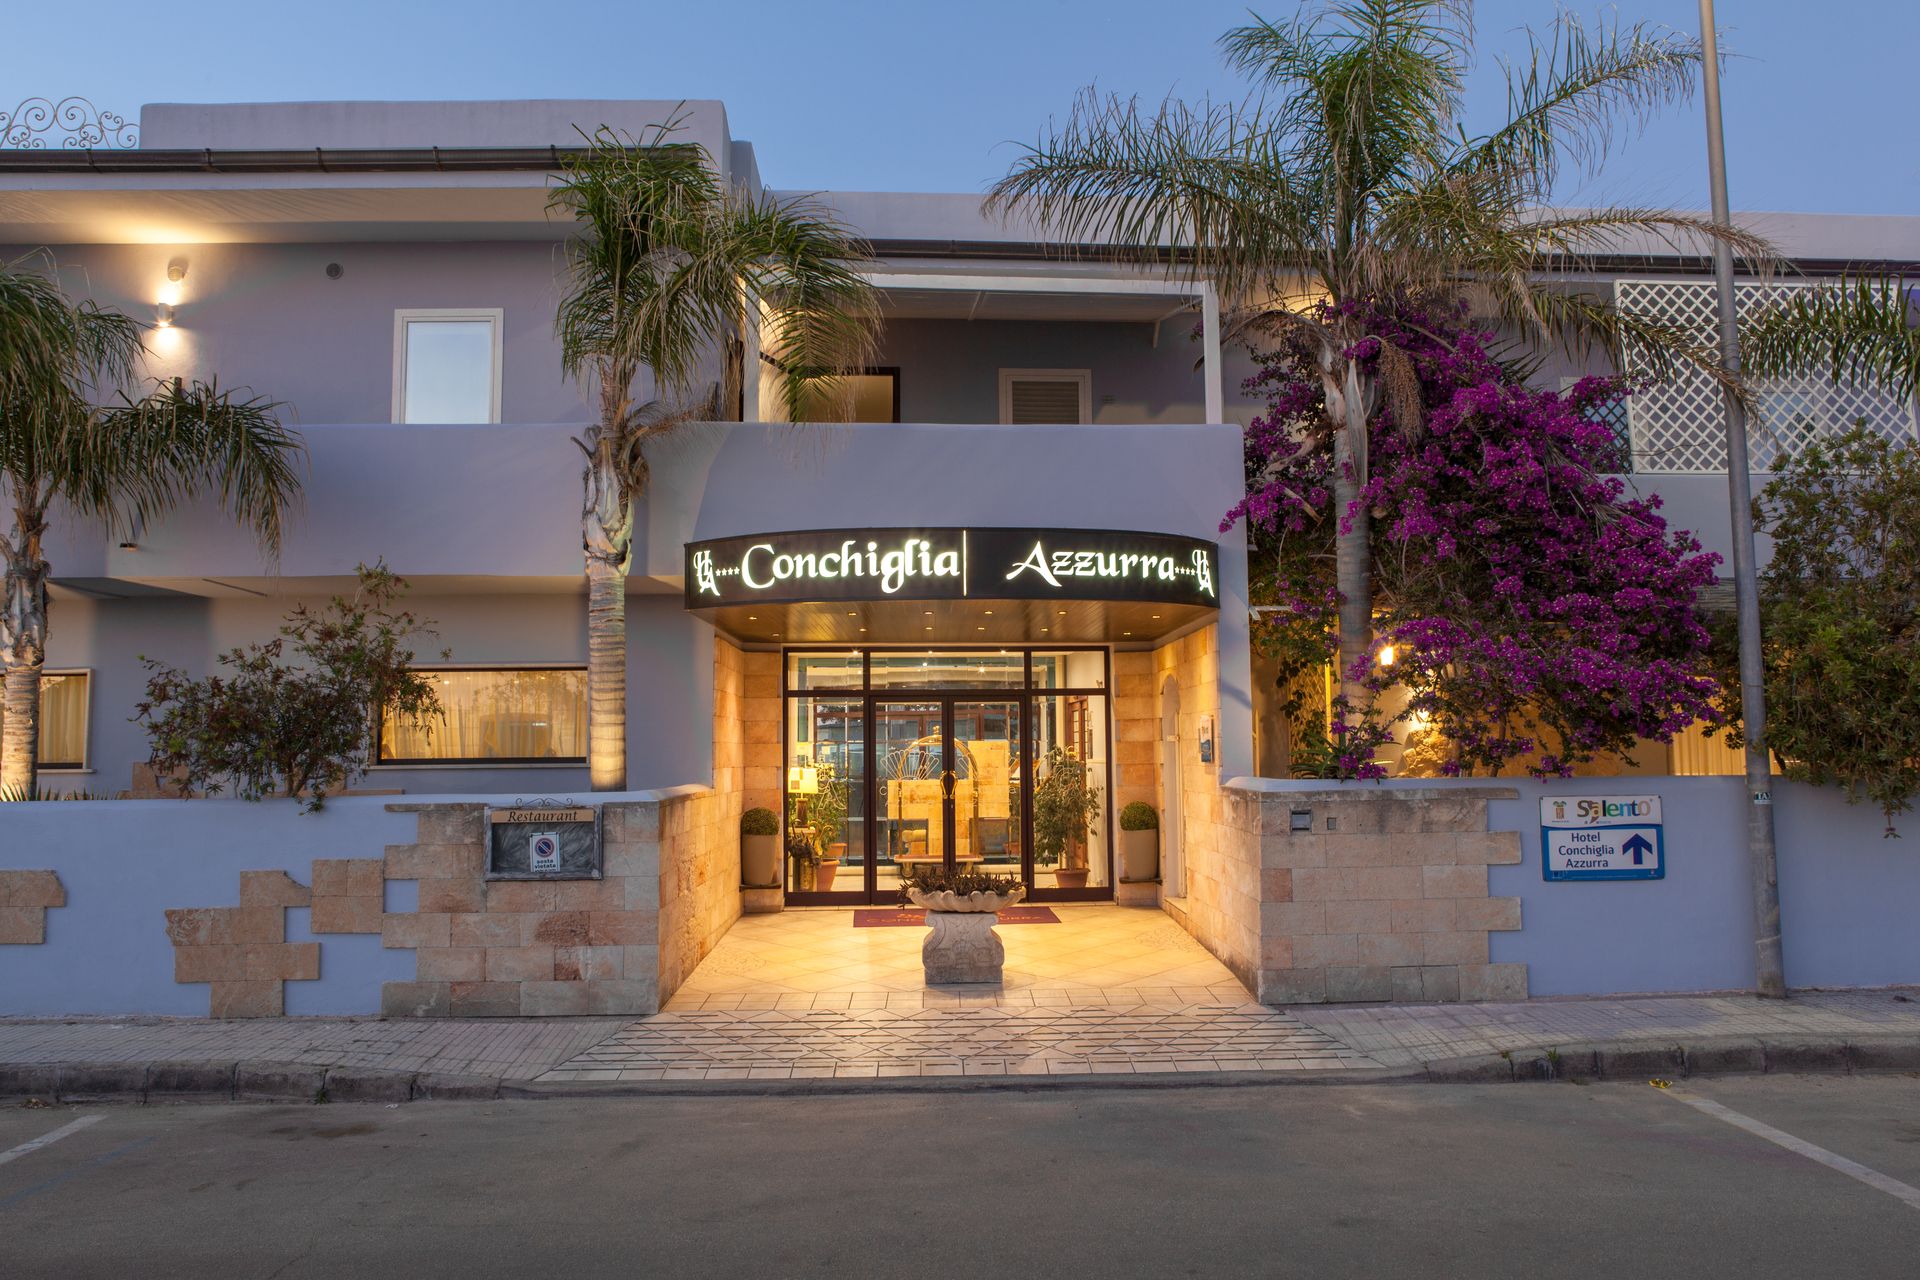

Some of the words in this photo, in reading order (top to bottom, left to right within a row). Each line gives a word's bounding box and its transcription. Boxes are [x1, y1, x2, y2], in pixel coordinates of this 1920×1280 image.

[741, 540, 960, 594] Conchiglia
[1005, 540, 1177, 587] Azzurra
[508, 811, 578, 822] Restaurant
[1572, 831, 1601, 843] Hotel
[1558, 844, 1615, 858] Conchiglia
[1565, 858, 1609, 868] Azzurra
